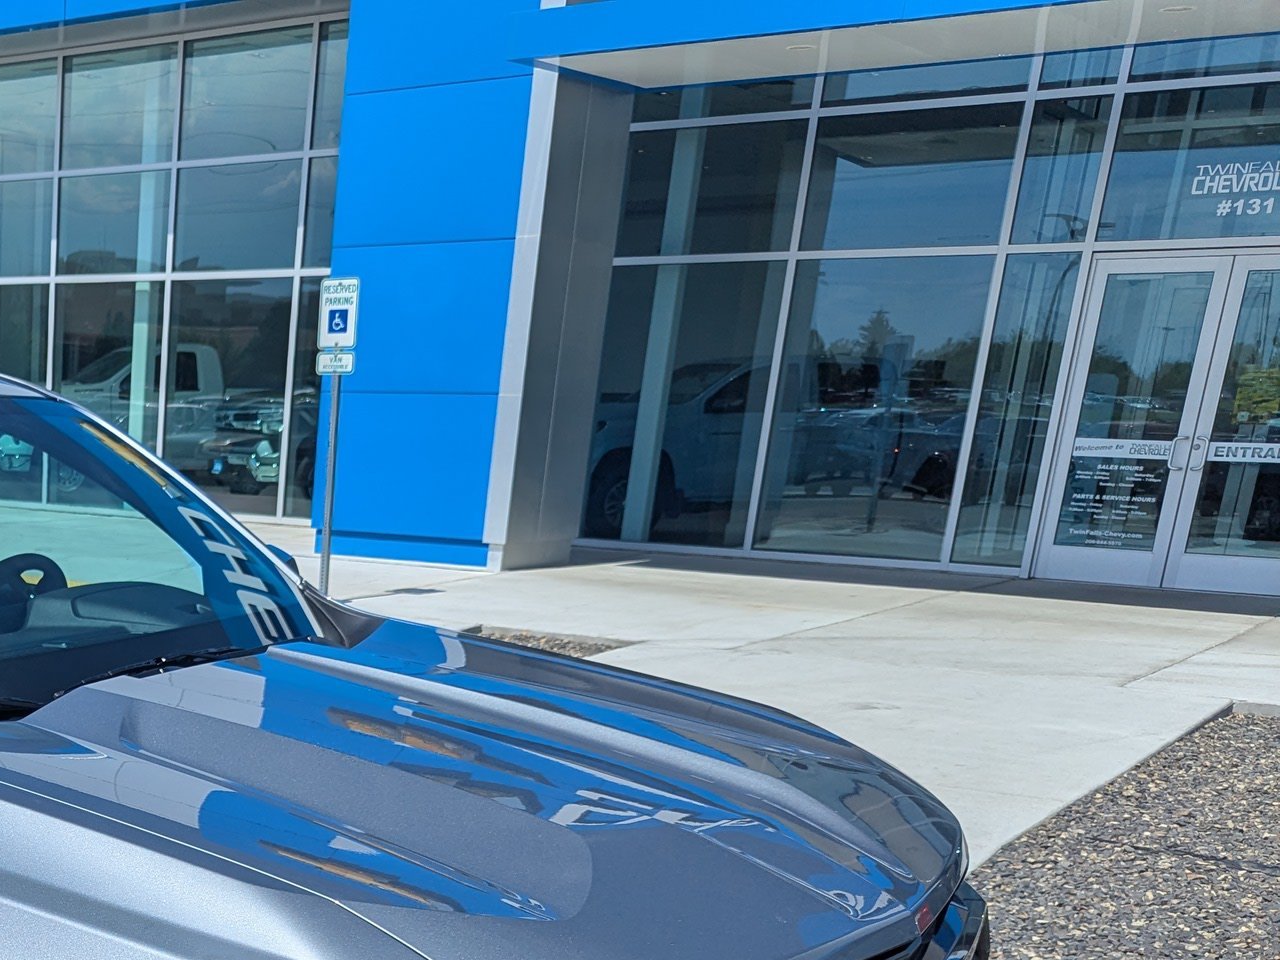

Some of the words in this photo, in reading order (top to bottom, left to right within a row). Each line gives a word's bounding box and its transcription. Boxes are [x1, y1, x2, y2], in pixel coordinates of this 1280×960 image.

[1216, 197, 1275, 217] #131
[323, 284, 357, 294] RESERVED
[324, 296, 354, 306] PARKING
[1075, 444, 1113, 452] Welcome
[1101, 494, 1131, 502] SERVICE
